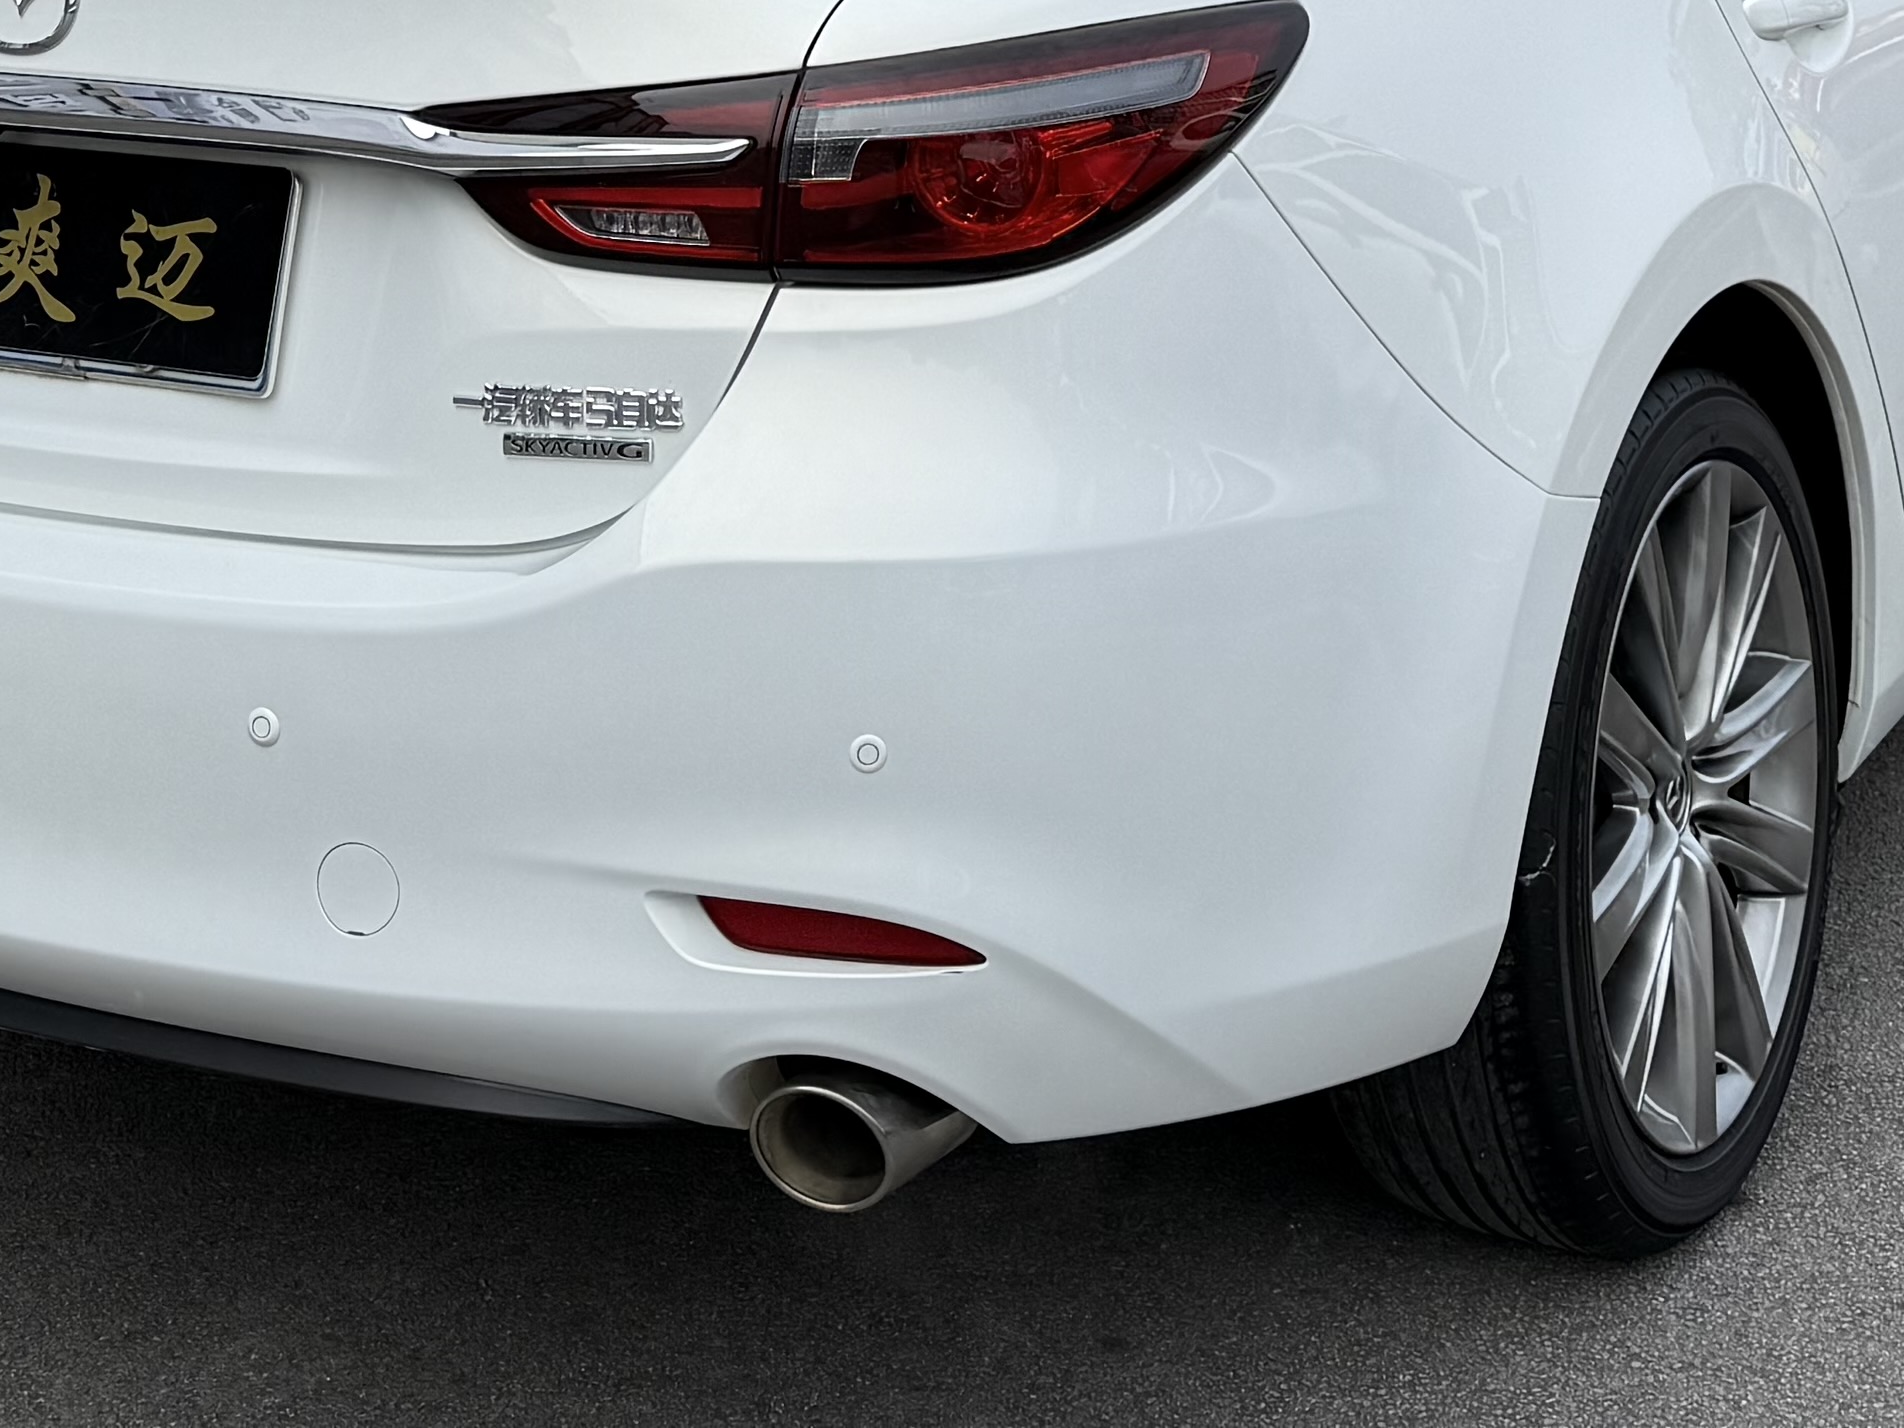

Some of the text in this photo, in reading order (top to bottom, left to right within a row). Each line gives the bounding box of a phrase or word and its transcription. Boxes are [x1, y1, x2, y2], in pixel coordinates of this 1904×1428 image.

[452, 383, 685, 430] 一汽轿车马自达
